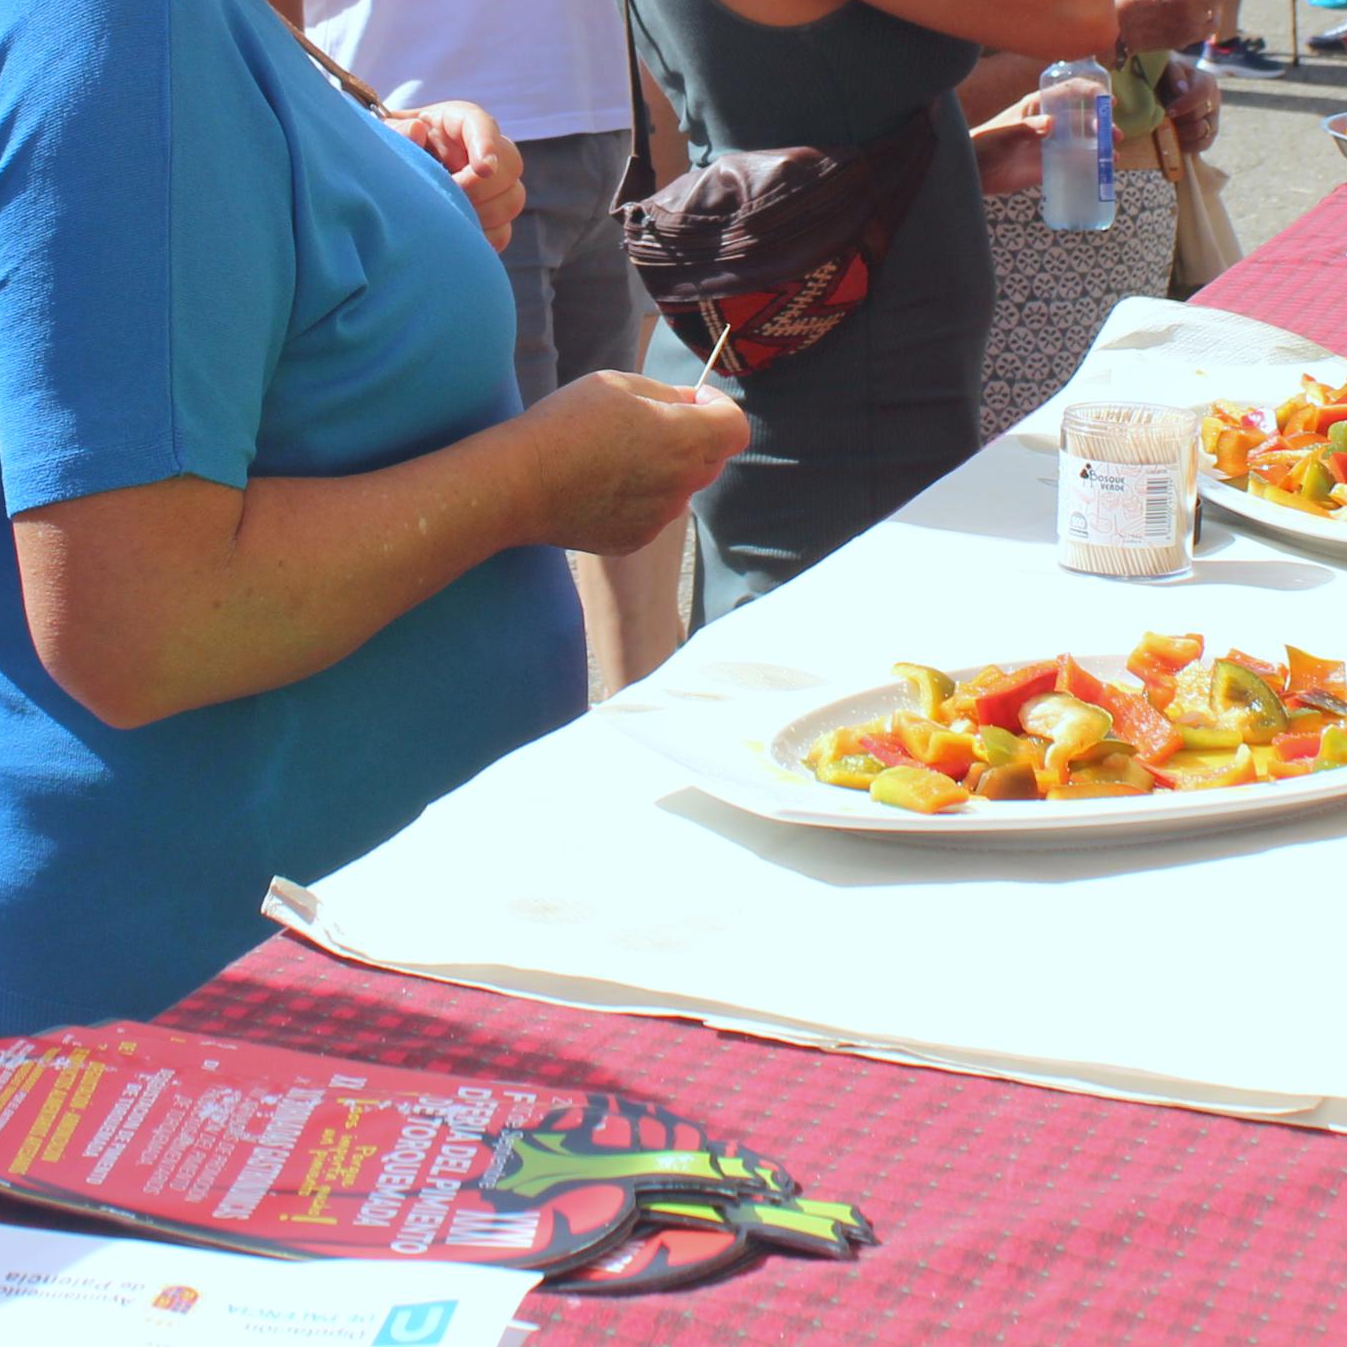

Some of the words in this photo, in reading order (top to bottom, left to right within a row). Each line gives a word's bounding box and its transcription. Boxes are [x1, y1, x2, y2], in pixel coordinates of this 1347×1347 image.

[1089, 469, 1125, 484] BOSQUE
[86, 1096, 136, 1158] TORQUEMADA
[447, 1098, 499, 1142] FERIA
[86, 1142, 123, 1184] PIMIENTO
[352, 1117, 440, 1227] TORQUEMADA
[430, 1146, 478, 1175] DEL
[389, 1178, 461, 1253] PIMIENTO
[3, 1272, 113, 1292] Palencia
